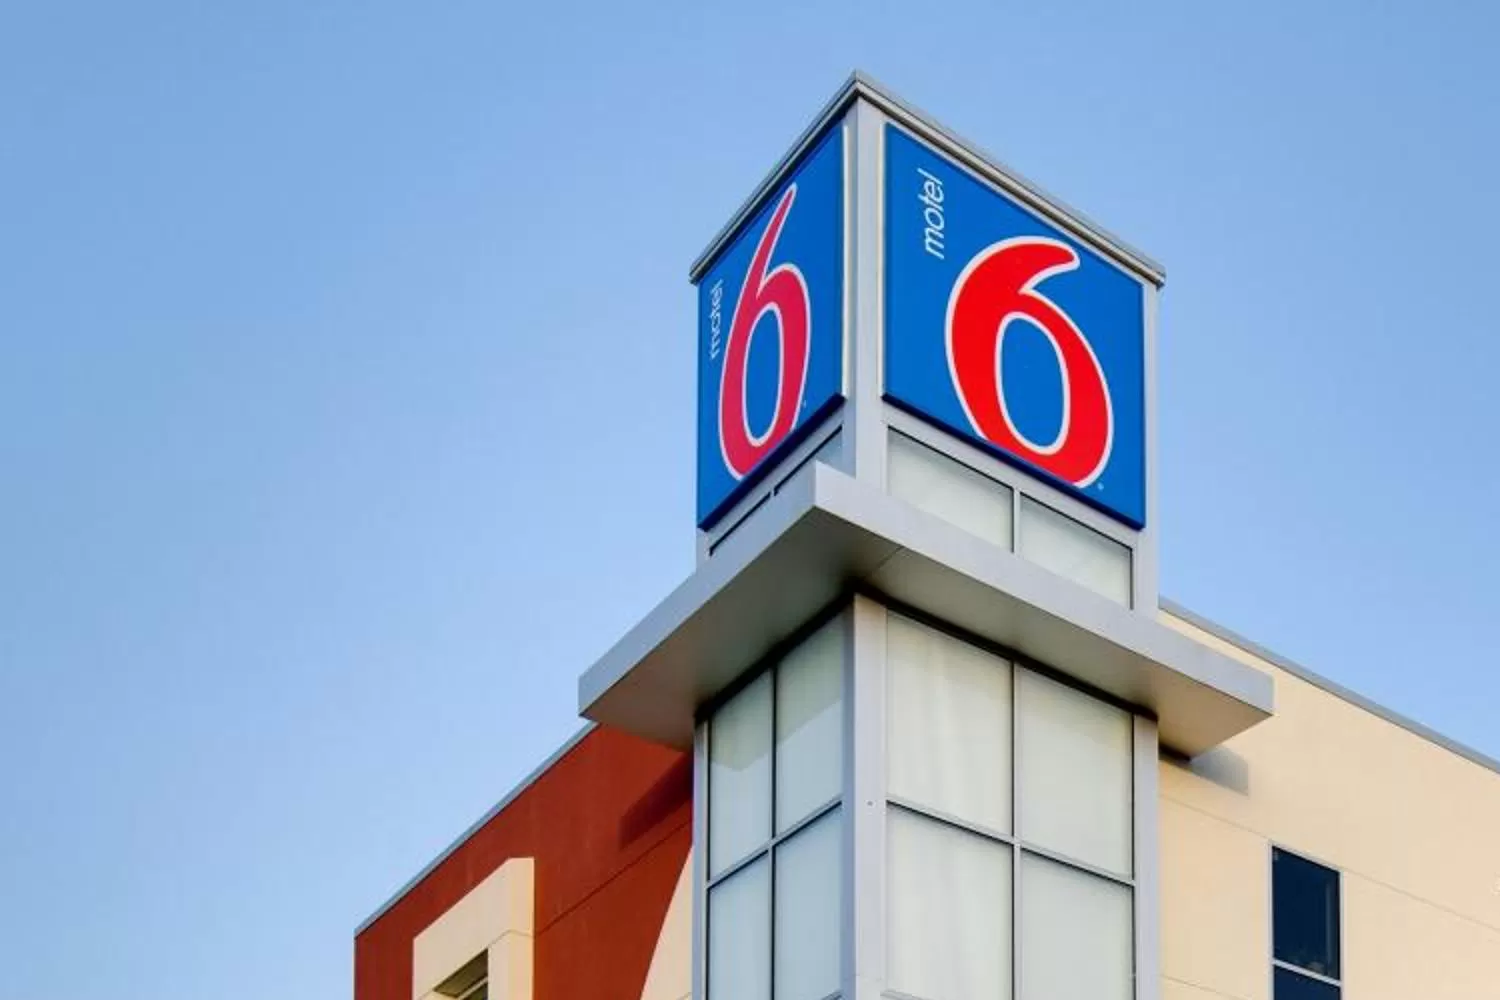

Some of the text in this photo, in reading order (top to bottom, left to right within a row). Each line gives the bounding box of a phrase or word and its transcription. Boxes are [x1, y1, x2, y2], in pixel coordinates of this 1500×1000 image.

[917, 167, 945, 260] motel
[709, 278, 724, 360] motel
[719, 182, 811, 481] 6
[944, 235, 1114, 489] 6
